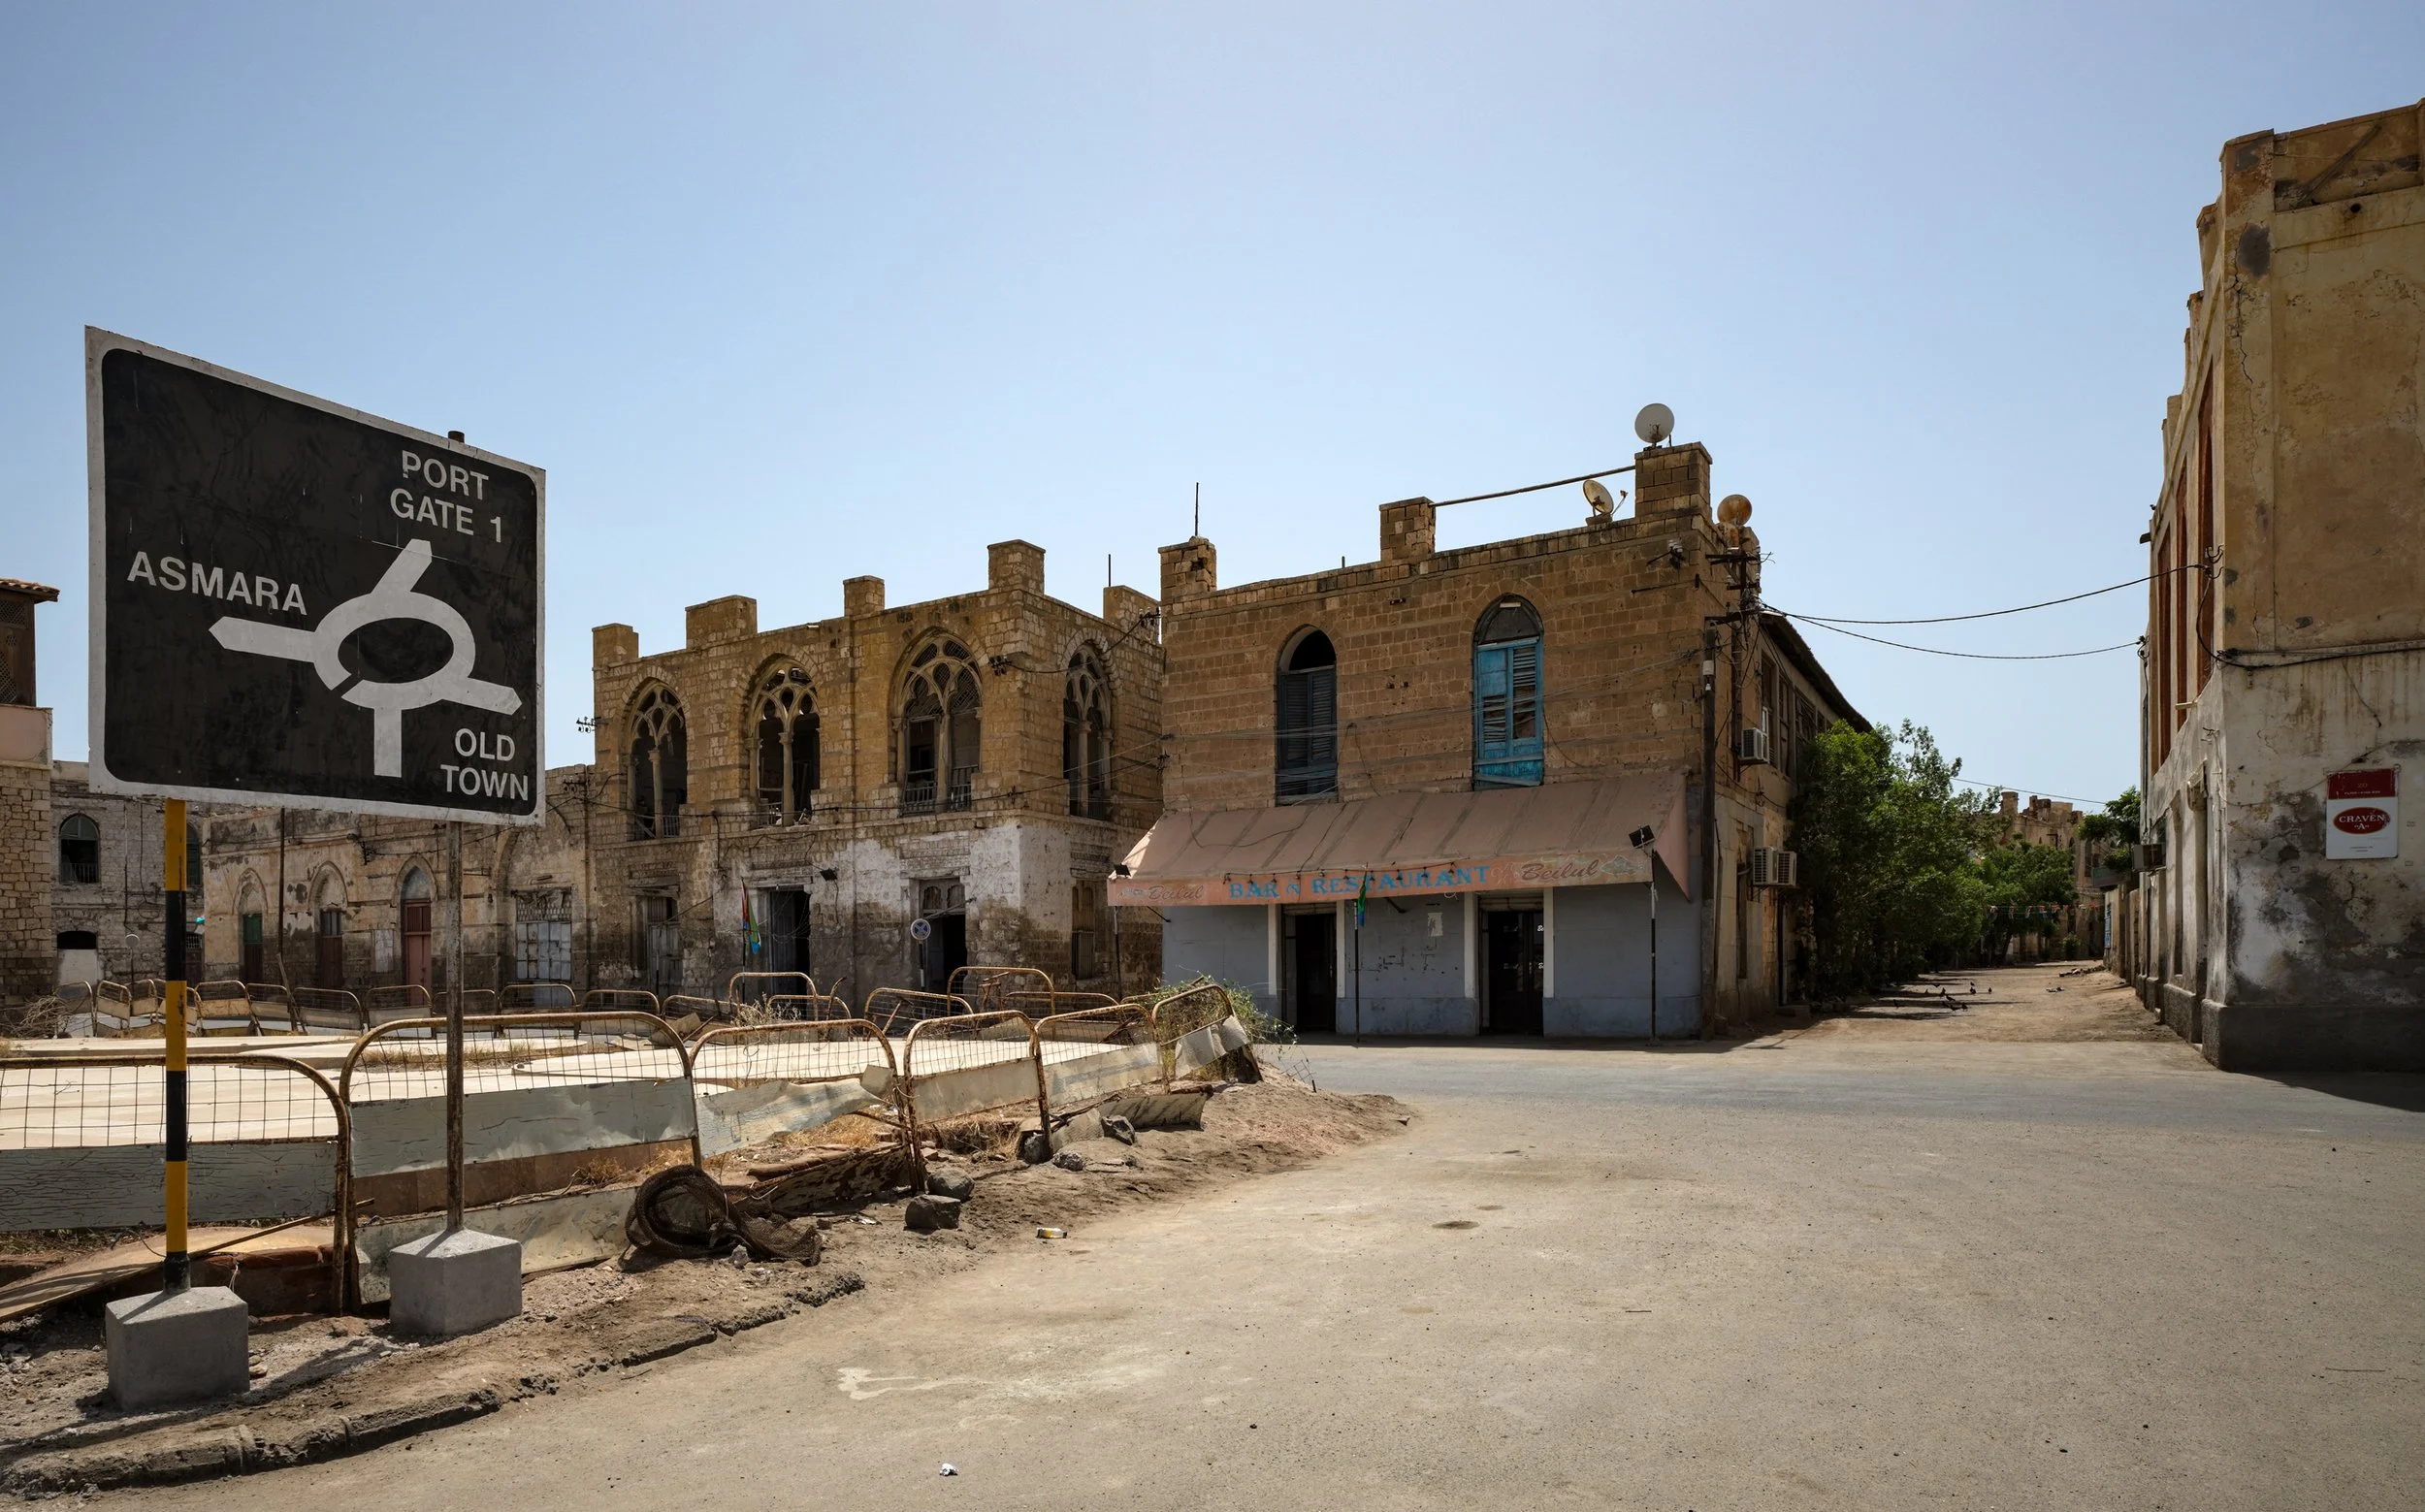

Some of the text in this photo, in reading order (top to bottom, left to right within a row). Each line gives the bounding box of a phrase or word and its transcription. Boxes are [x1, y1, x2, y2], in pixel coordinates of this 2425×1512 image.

[402, 450, 489, 500] PORT
[390, 487, 502, 543] GATE 1
[127, 551, 307, 616] ASMARA
[454, 727, 516, 761] OLD
[440, 763, 529, 801] TOWN
[2339, 814, 2385, 823] CRAVEN
[1229, 882, 1279, 899] BAR
[1311, 865, 1491, 894] RESTAURANT
[1521, 859, 1600, 881] Beilul
